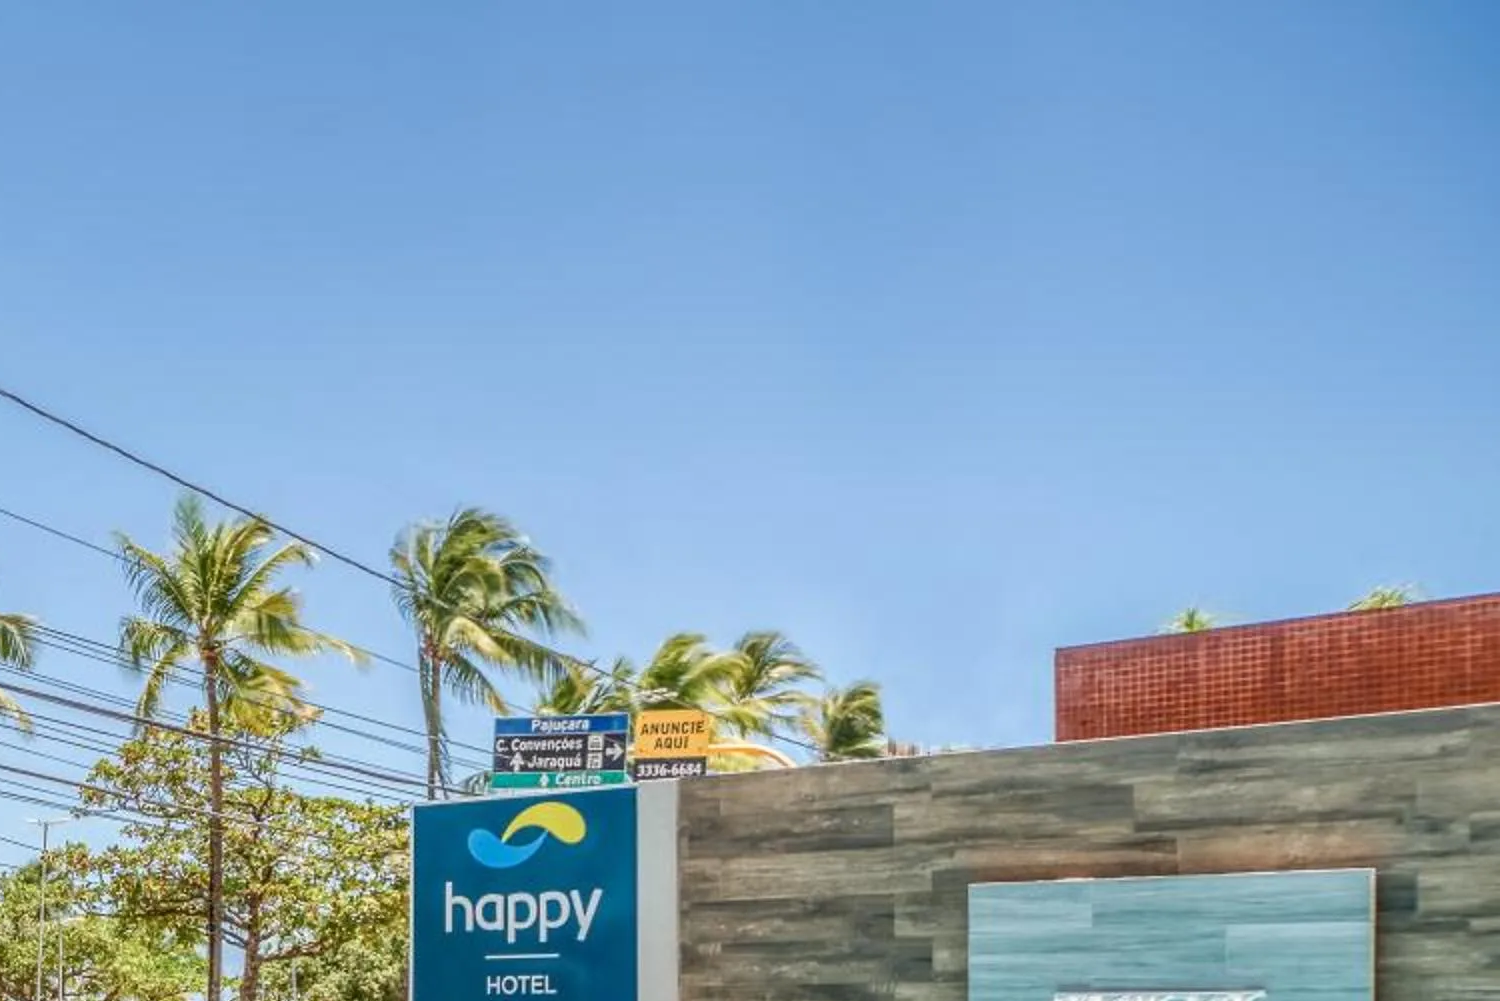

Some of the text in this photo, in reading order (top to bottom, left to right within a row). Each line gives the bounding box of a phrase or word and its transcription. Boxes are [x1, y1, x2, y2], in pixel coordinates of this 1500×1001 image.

[531, 719, 590, 733] Pajuçara
[640, 720, 705, 736] ANUNCIE
[496, 739, 509, 752] C.
[527, 753, 582, 770] Jaraguá
[555, 772, 602, 785] Centro
[445, 880, 603, 944] happy
[486, 974, 557, 995] HOTEL
